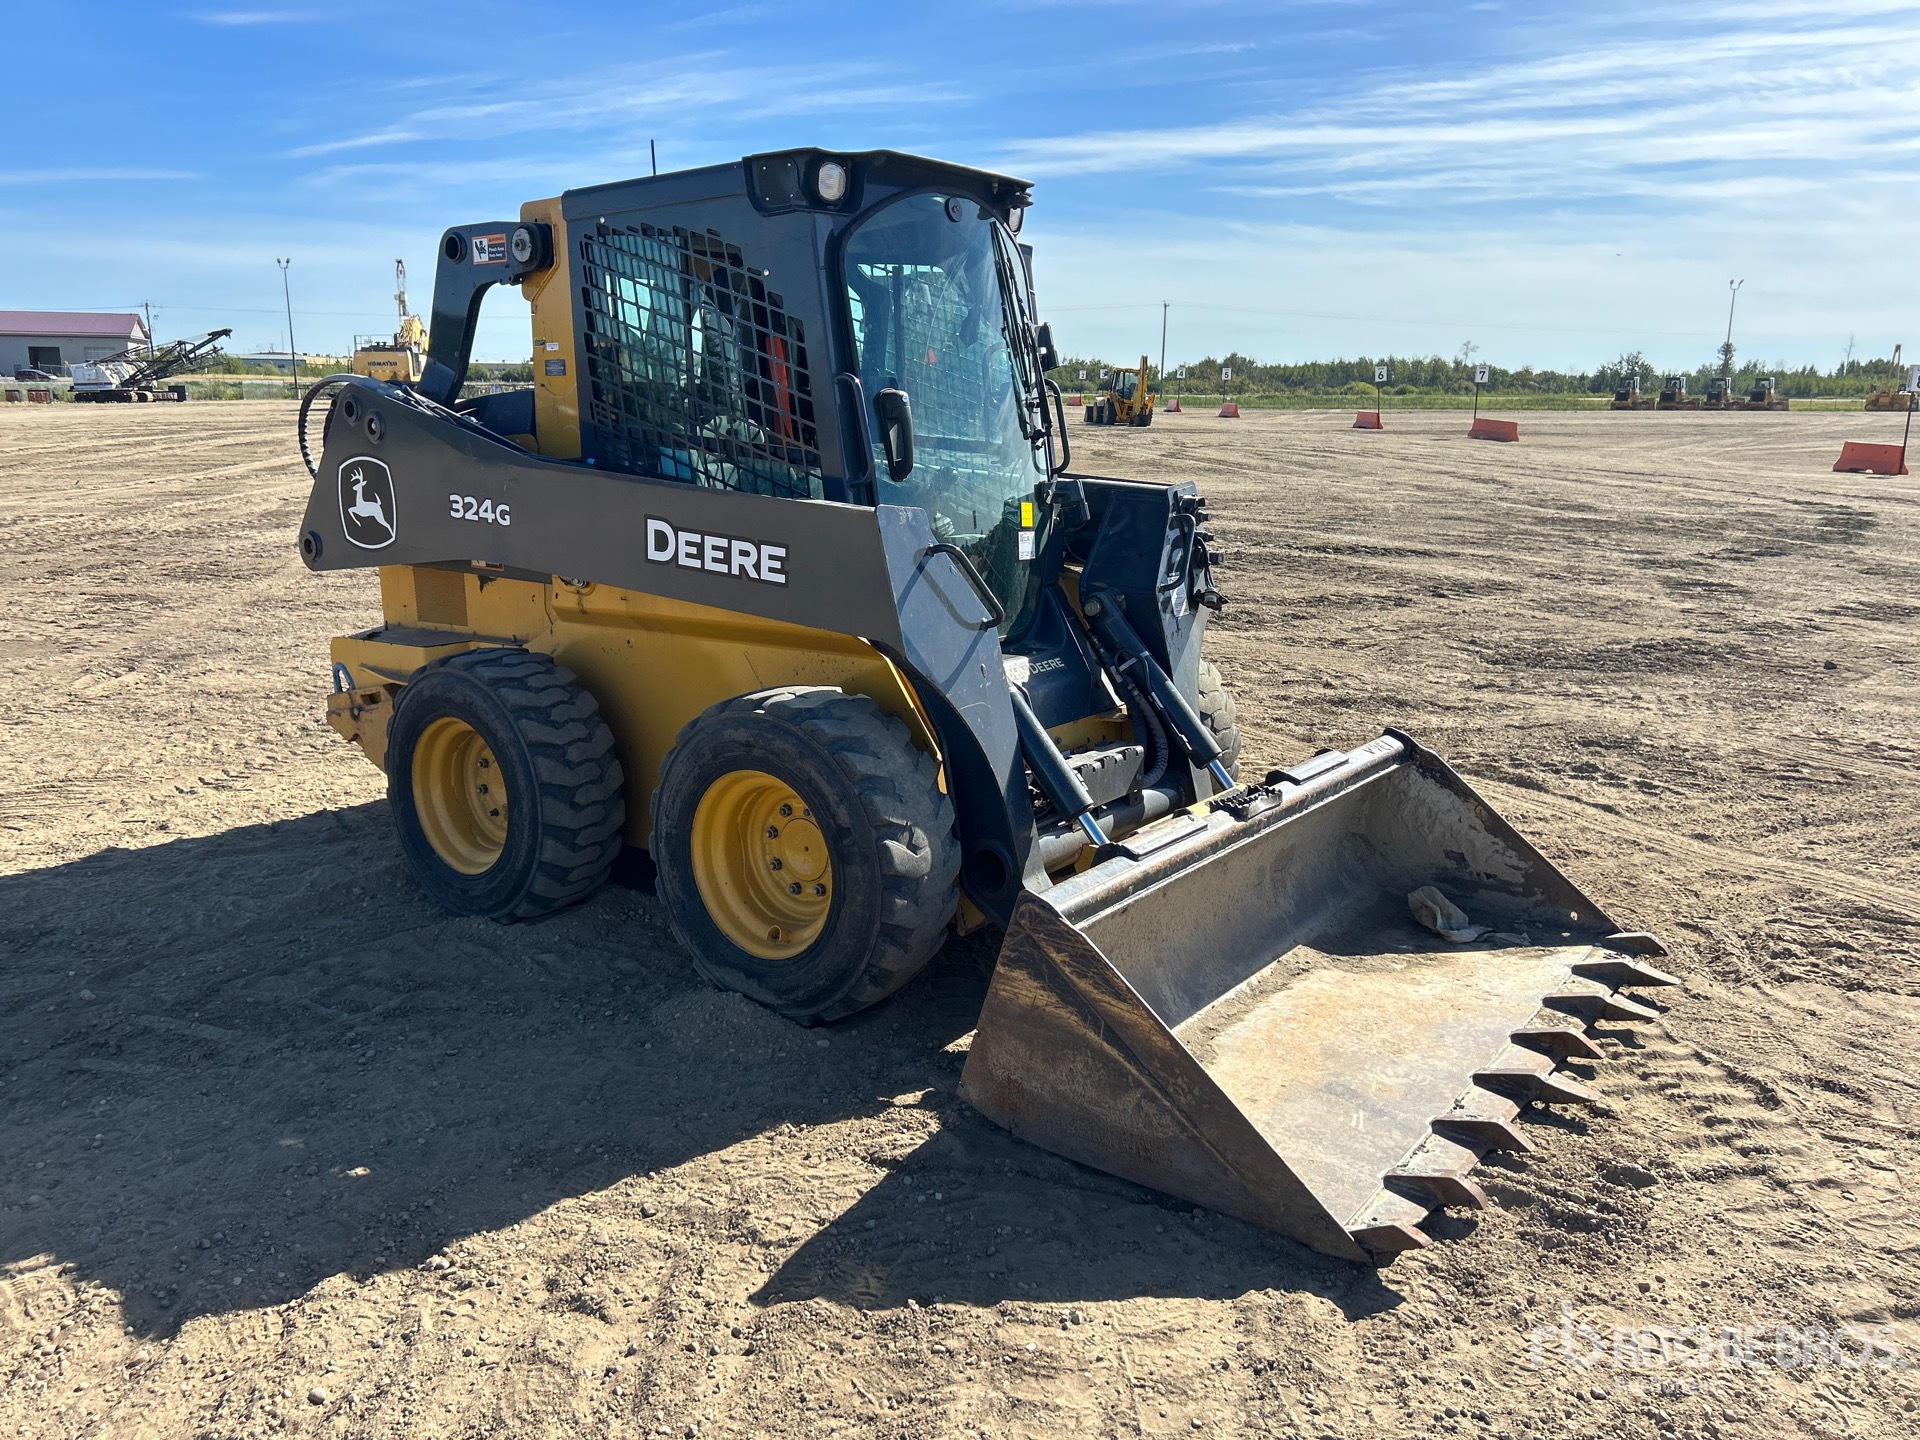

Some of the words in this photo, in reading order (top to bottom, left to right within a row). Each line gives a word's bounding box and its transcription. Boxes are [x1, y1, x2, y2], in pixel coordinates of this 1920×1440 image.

[1378, 370, 1384, 380] 6
[1479, 370, 1486, 381] 7
[449, 494, 511, 526] 324G
[645, 517, 787, 585] DEERE
[1029, 657, 1065, 674] DEERE
